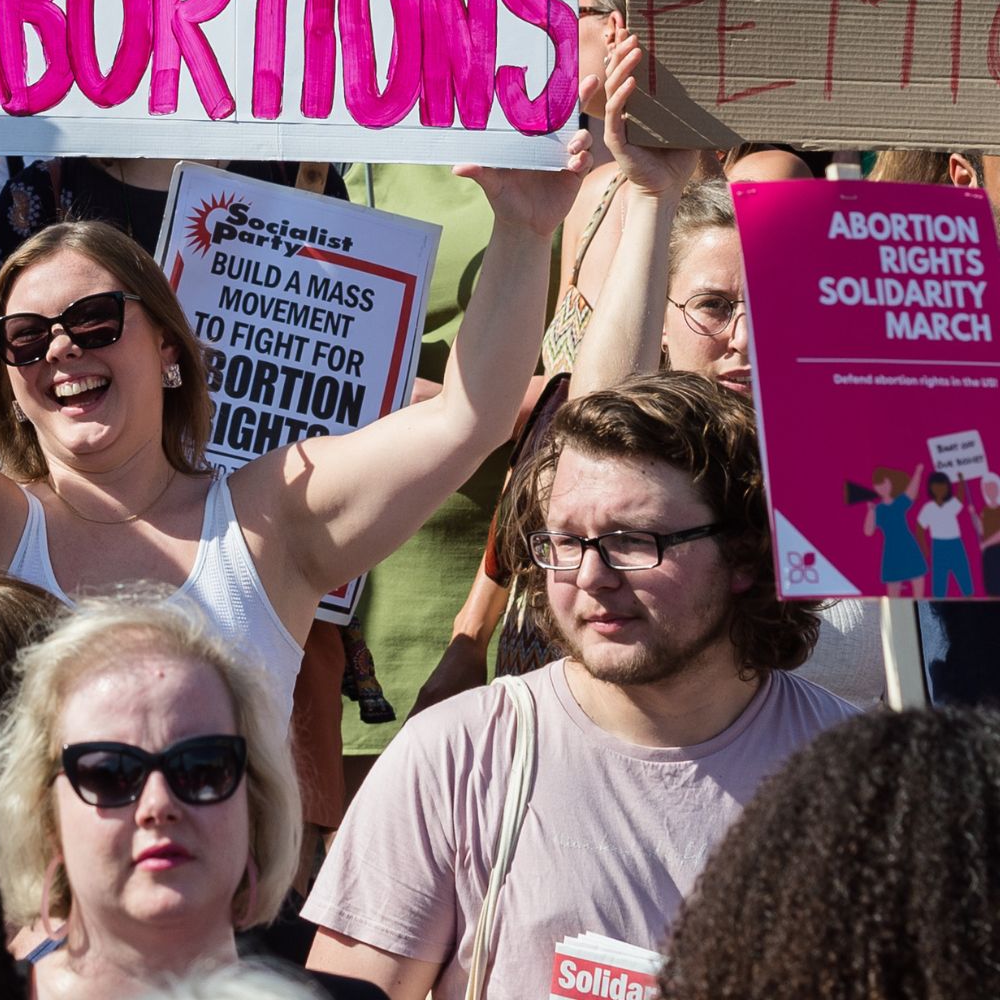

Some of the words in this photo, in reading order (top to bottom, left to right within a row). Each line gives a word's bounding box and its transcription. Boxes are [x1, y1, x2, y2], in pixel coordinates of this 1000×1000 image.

[210, 220, 303, 259] Party
[225, 201, 354, 253] Socialist
[827, 210, 981, 245] ABORTION
[878, 245, 985, 277] RIGHTS
[209, 250, 283, 290] BUILD
[284, 269, 302, 295] A
[306, 273, 376, 314] MASS
[817, 275, 988, 310] SOLIDARITY
[217, 285, 356, 340] MOVEMENT
[885, 310, 993, 343] MARCH
[193, 310, 226, 343] TO
[228, 320, 310, 363] FIGHT
[310, 341, 366, 379] FOR
[832, 373, 874, 386] Defend
[874, 374, 919, 387] abortion
[919, 374, 951, 389] rights
[951, 375, 962, 388] in
[962, 376, 980, 388] the
